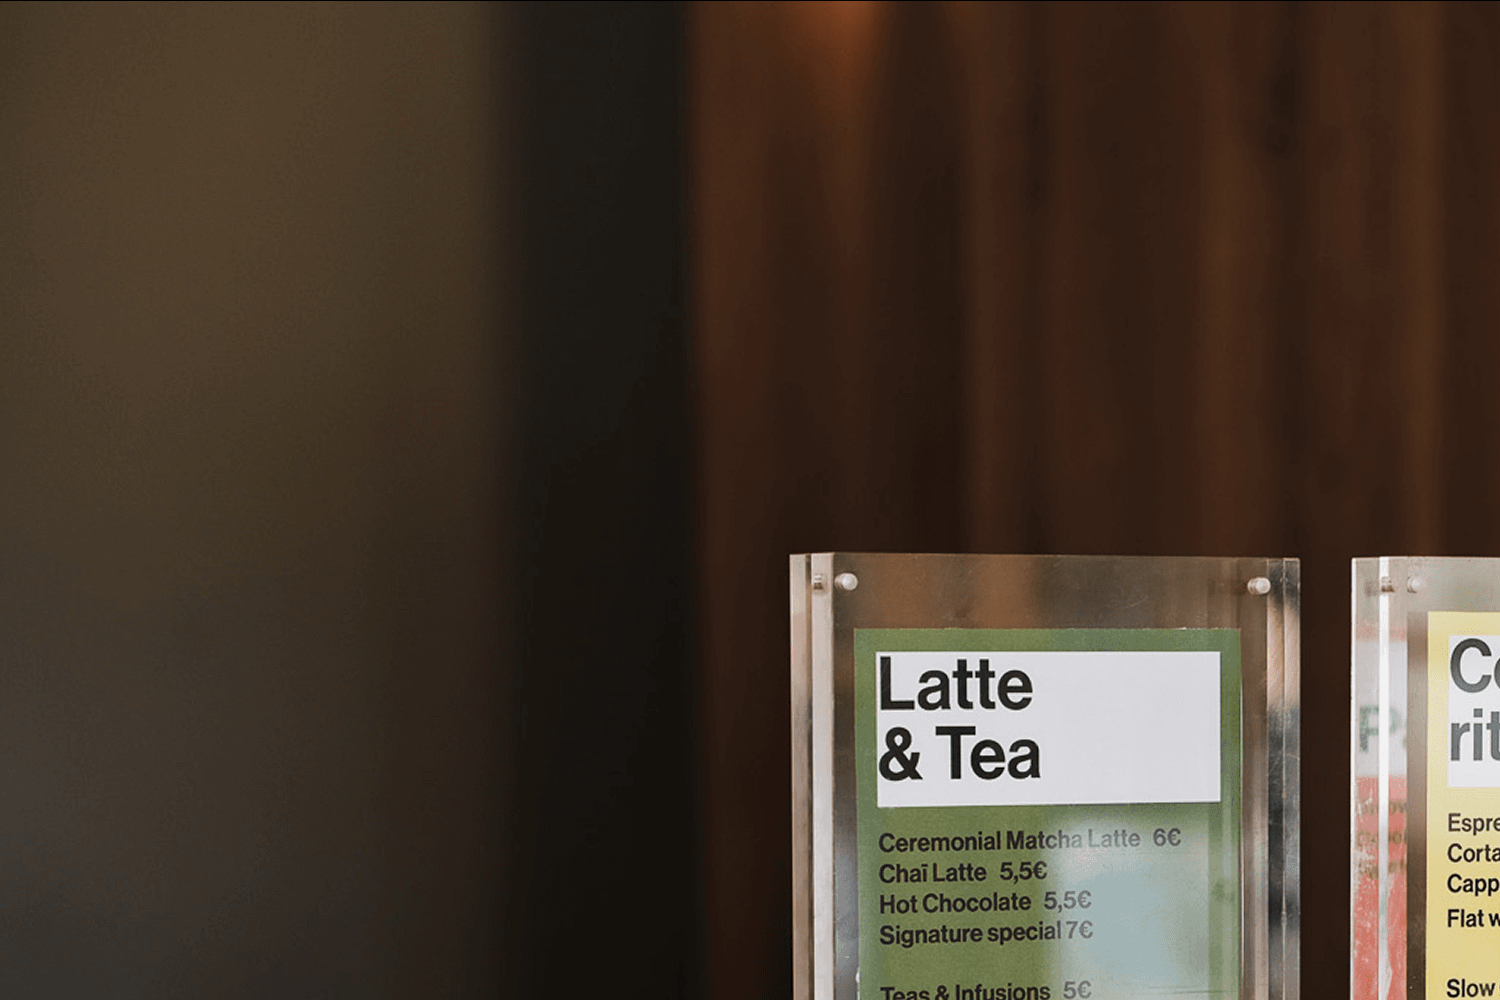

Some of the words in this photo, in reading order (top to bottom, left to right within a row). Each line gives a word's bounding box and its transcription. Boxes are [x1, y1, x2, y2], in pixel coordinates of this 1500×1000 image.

[880, 656, 1033, 710] Latte
[879, 726, 923, 781] &
[935, 726, 1041, 780] Tea
[878, 831, 1001, 853] Ceremonial
[1006, 829, 1083, 850] Matcha
[1088, 828, 1141, 848] Latte
[1152, 828, 1181, 847] 6€
[933, 862, 987, 882] Latte
[1000, 861, 1047, 884] 5,5€
[879, 894, 918, 914] Hot
[922, 893, 1032, 914] Chocolate
[1043, 890, 1092, 913] 5,5€
[1447, 908, 1484, 927] Flat
[879, 924, 983, 948] Signature
[987, 921, 1062, 945] special
[1066, 920, 1093, 940] 7€
[1063, 980, 1092, 1000] 5€
[1446, 978, 1496, 998] Slow
